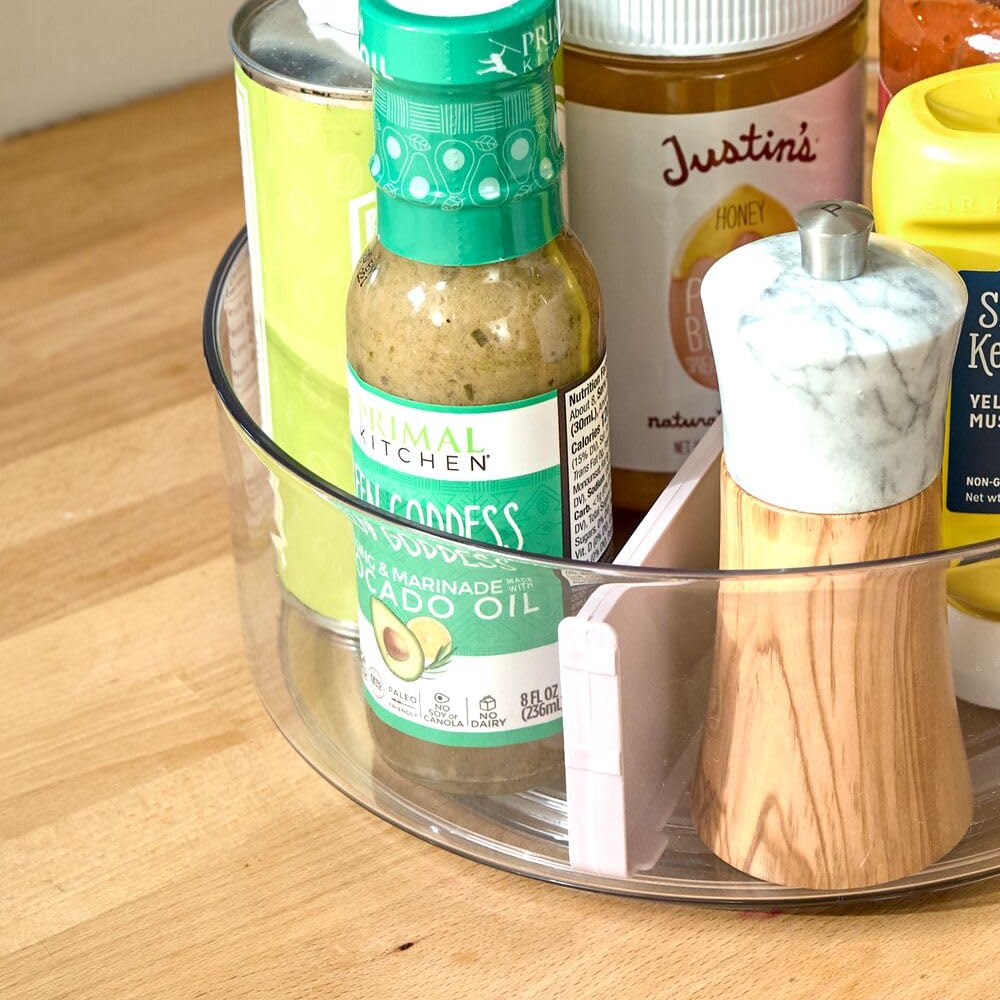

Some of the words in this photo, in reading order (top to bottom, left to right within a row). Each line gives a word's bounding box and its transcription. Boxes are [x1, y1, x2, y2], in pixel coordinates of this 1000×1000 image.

[661, 121, 817, 187] Justin's
[716, 200, 766, 231] HONEY
[569, 374, 600, 407] Nutrition
[570, 399, 590, 421] About
[360, 425, 487, 471] KITCHEN
[571, 425, 600, 454] Calories
[966, 492, 986, 503] Net
[392, 567, 503, 596] MARINADE
[474, 592, 540, 620] OIL
[388, 685, 417, 704] PALEO
[520, 692, 528, 707] 8
[530, 688, 543, 705] FL
[544, 683, 559, 701] OZ
[428, 708, 446, 719] SOY
[435, 703, 450, 713] NO
[480, 711, 498, 720] NO
[423, 714, 464, 727] CANOLA
[471, 718, 506, 728] DAIRY
